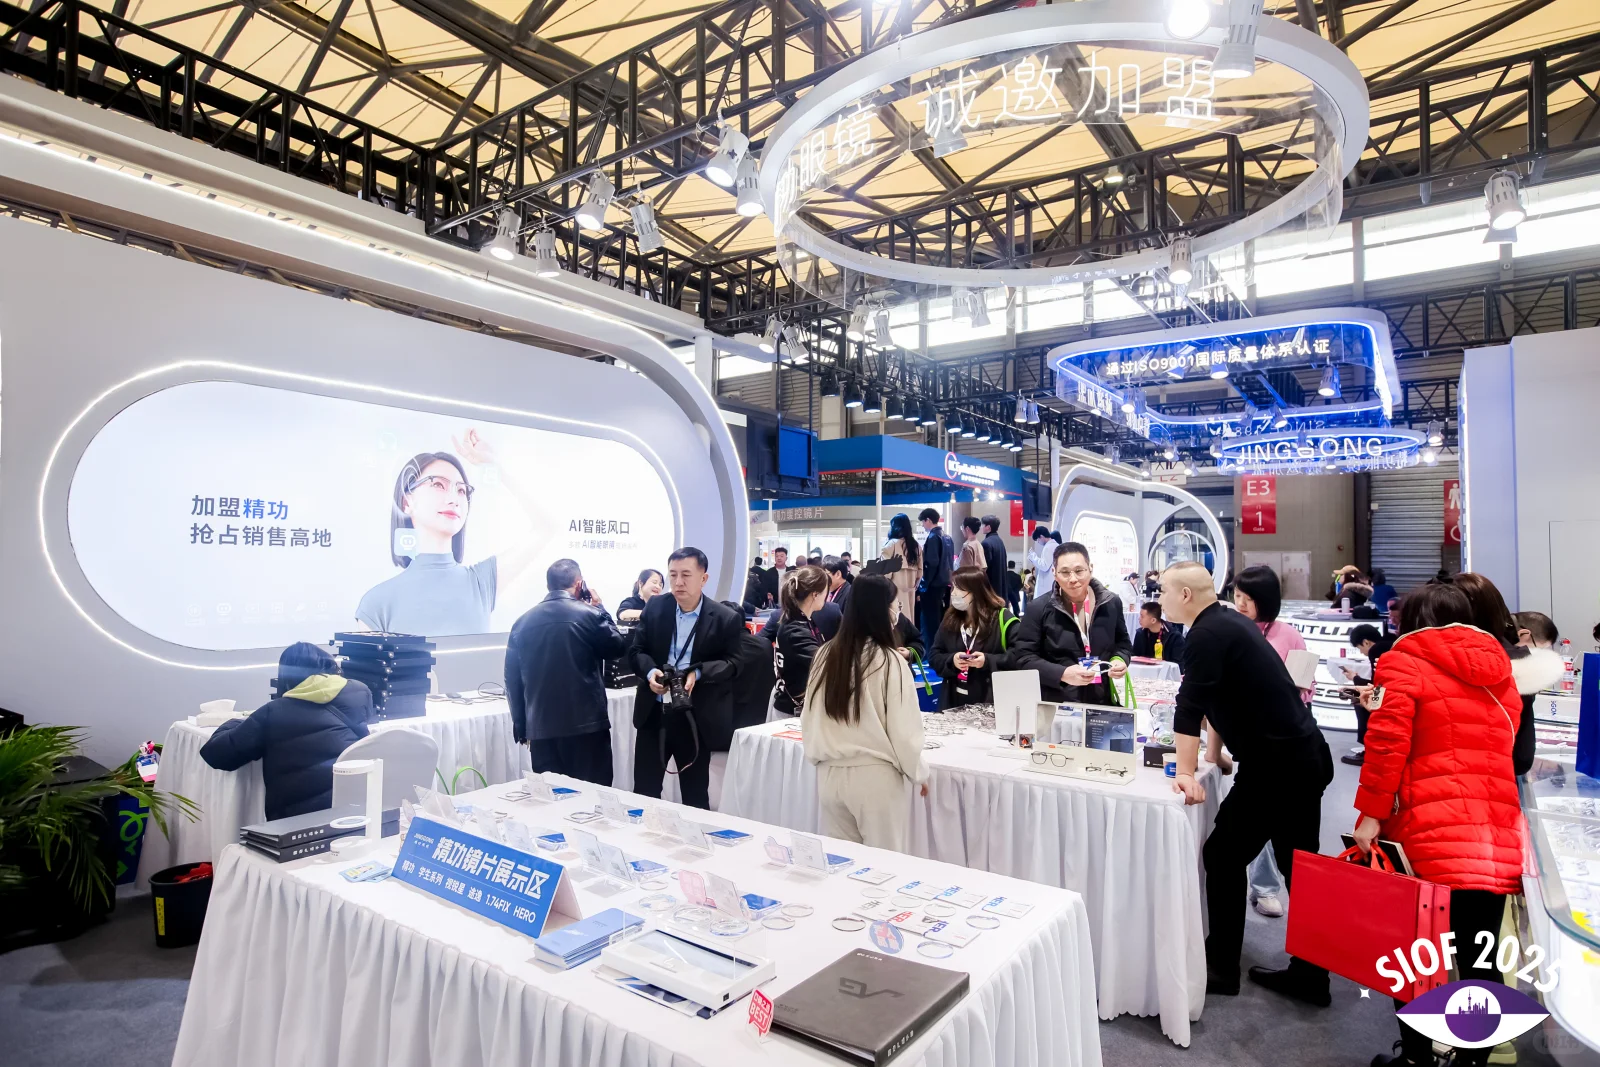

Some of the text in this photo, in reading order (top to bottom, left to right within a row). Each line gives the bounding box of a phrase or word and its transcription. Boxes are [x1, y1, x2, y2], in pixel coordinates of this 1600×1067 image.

[917, 51, 1221, 139] 诚邀加盟
[1106, 338, 1331, 376] 通过ISO9001国际质量体系认证
[1236, 437, 1382, 464] JINGGONG
[1247, 480, 1270, 496] E3
[191, 495, 289, 520] 加盟精功
[1255, 511, 1263, 527] 1
[190, 522, 332, 548] 抢占销售高地
[568, 518, 630, 534] AI智能风口
[432, 836, 551, 900] 精功镜片展示区
[401, 859, 416, 874] 精功
[418, 866, 445, 886] 学生系列
[485, 893, 512, 914] 1.74FIX
[513, 905, 536, 924] HERO
[750, 1002, 769, 1027] BEST
